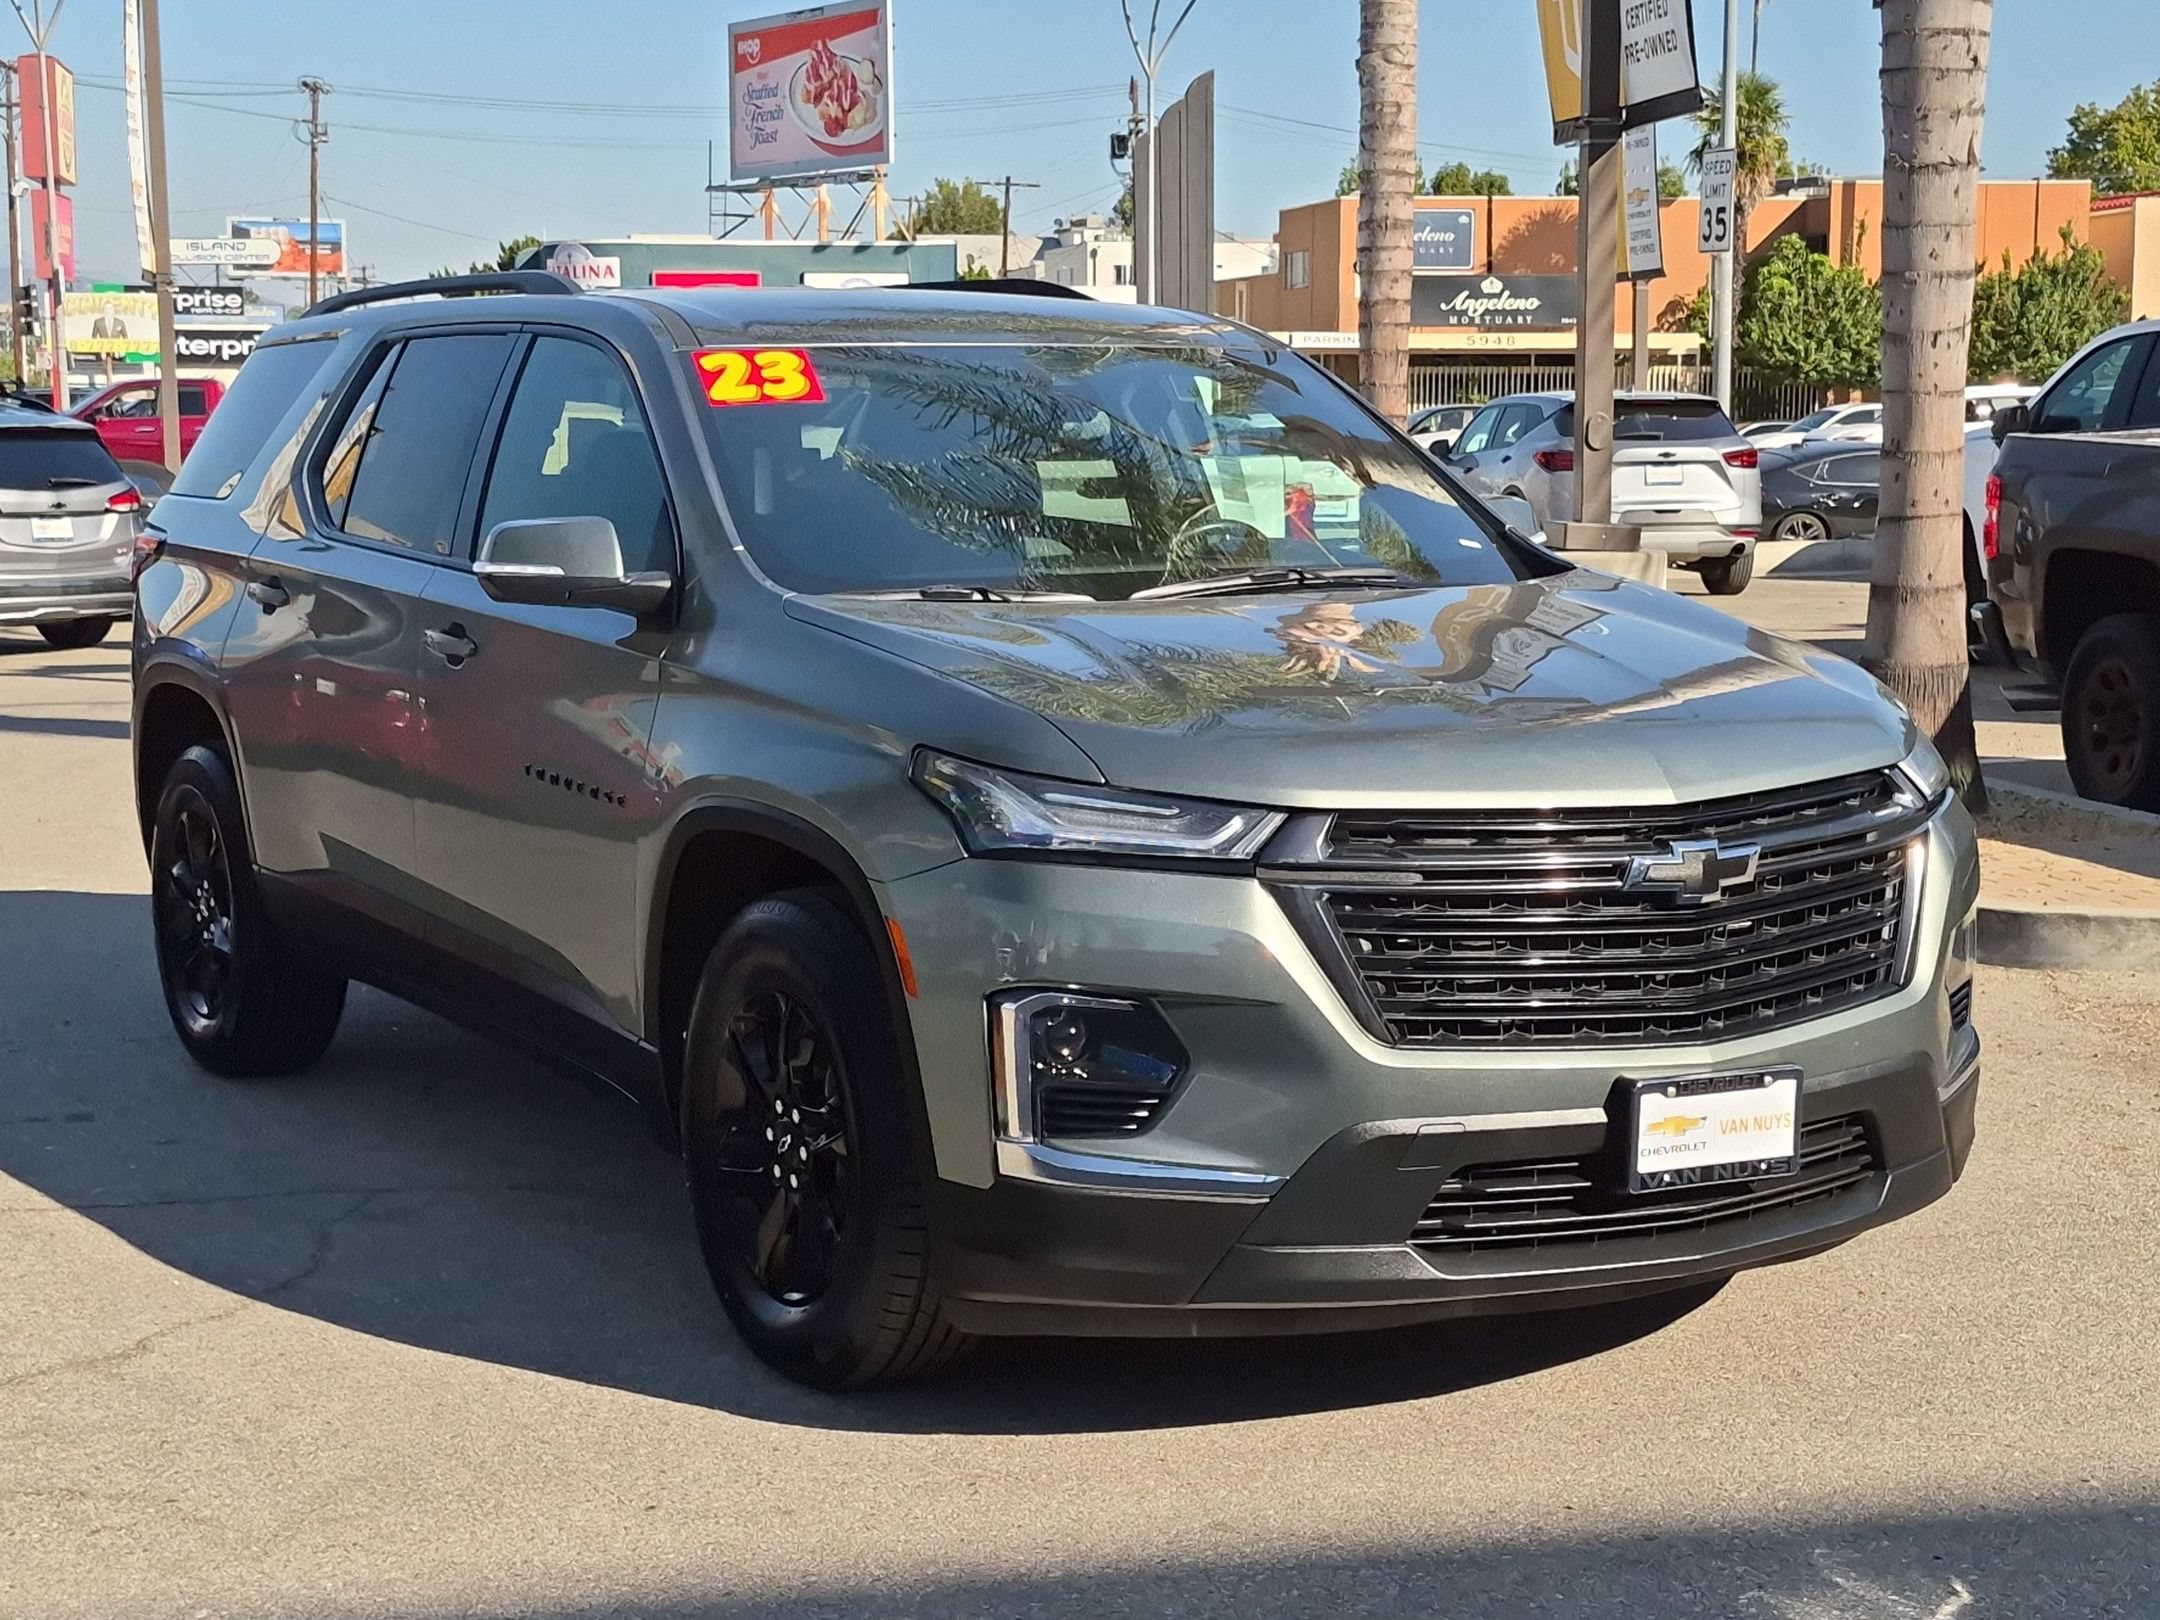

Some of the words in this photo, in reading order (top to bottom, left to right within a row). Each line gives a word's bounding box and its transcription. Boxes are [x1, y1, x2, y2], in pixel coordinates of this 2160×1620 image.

[1625, 0, 1669, 31] CERTIFIED
[1624, 28, 1679, 67] PRE-OWNED
[1704, 159, 1732, 176] SPEED
[1705, 183, 1727, 199] LIMIT
[1702, 206, 1727, 243] 35
[186, 242, 247, 251] ISLAND
[1440, 289, 1541, 317] Angeleno
[1449, 315, 1533, 325] MORTUARY
[1466, 335, 1516, 346] 5948
[699, 350, 812, 404] 23
[1679, 1074, 1761, 1095] CHEVROLET
[1719, 1118, 1749, 1136] VAN
[1752, 1112, 1793, 1132] NUYS
[1640, 1141, 1708, 1158] CHEVROLET
[1642, 1167, 1702, 1189] VAN
[1712, 1157, 1789, 1180] NUYS
